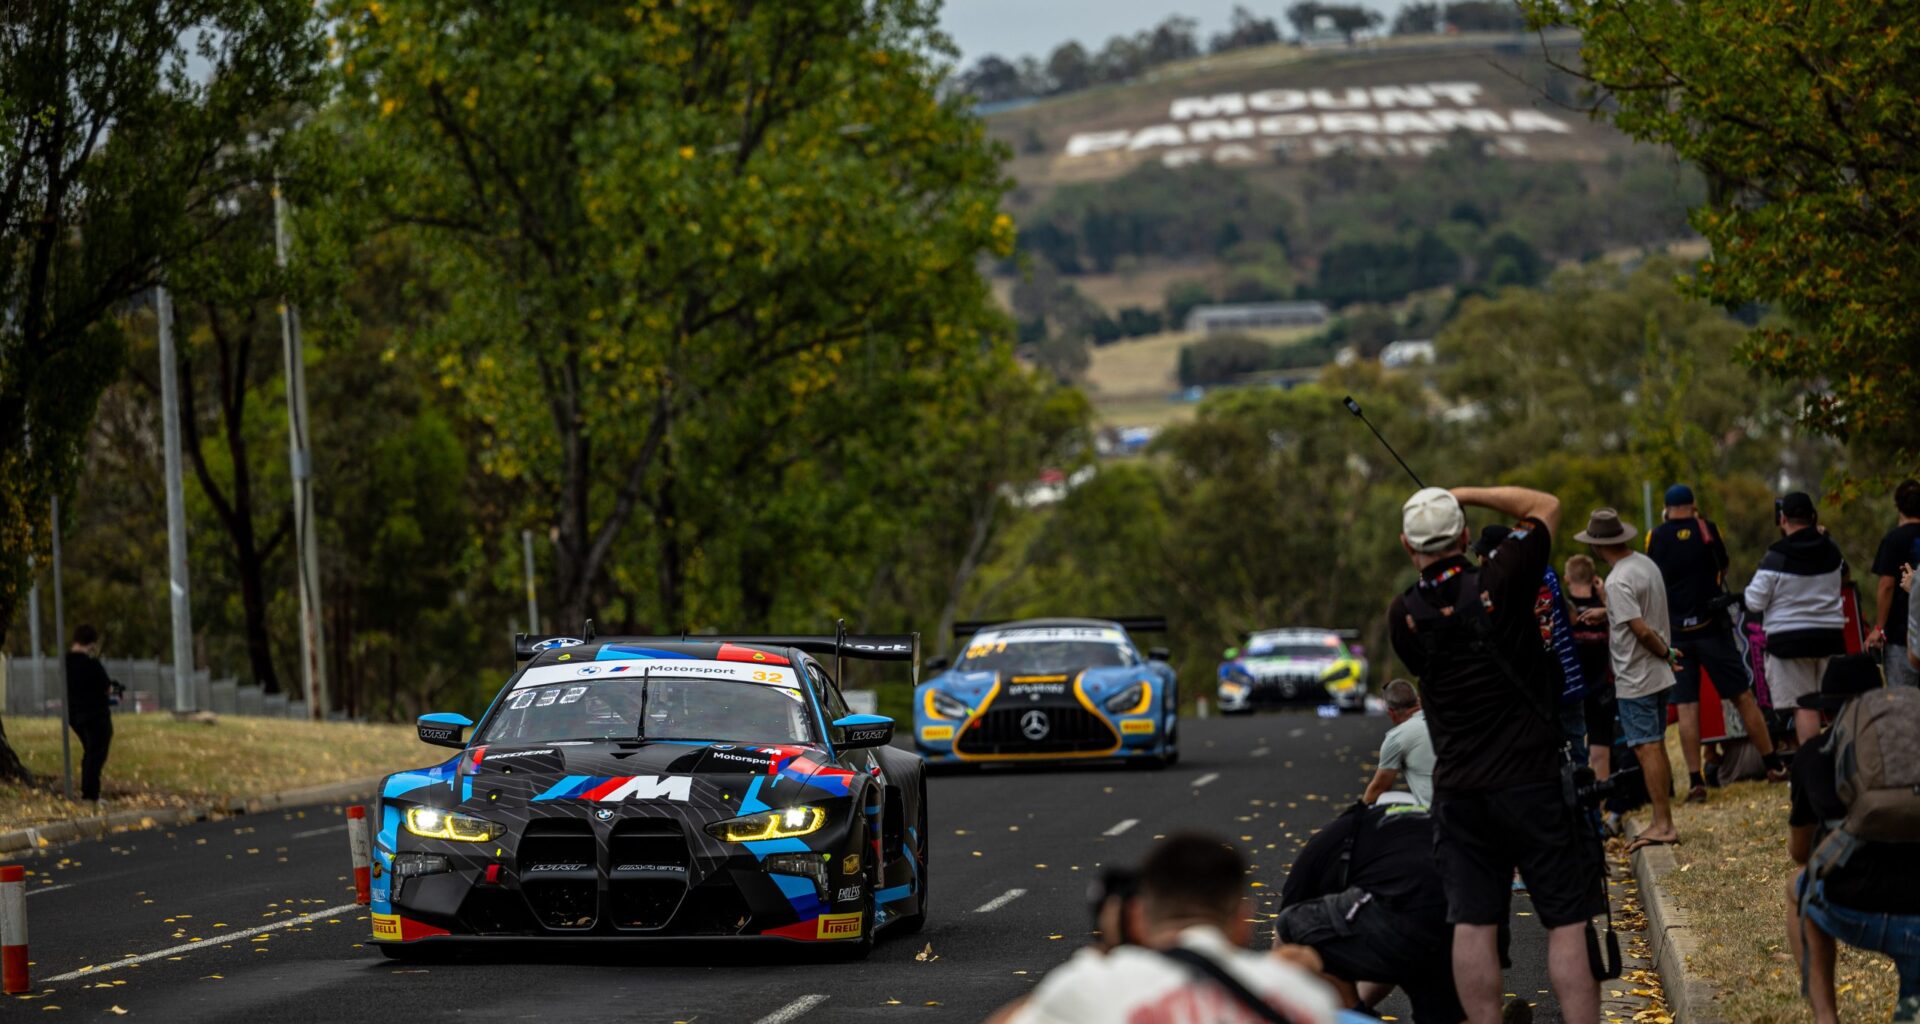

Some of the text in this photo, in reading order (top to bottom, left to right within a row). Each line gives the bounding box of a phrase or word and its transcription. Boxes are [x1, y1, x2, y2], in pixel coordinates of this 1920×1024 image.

[1170, 81, 1483, 120] MOUNT
[1066, 108, 1572, 157] PANORAMA
[649, 665, 737, 675] Motorsport
[752, 670, 784, 683] 32
[510, 686, 589, 710] 032
[421, 728, 452, 740] WRT
[852, 729, 888, 741] WRT
[713, 752, 777, 766] Motorsport
[838, 884, 861, 901] ENDLESS
[823, 917, 860, 934] PIRELLI
